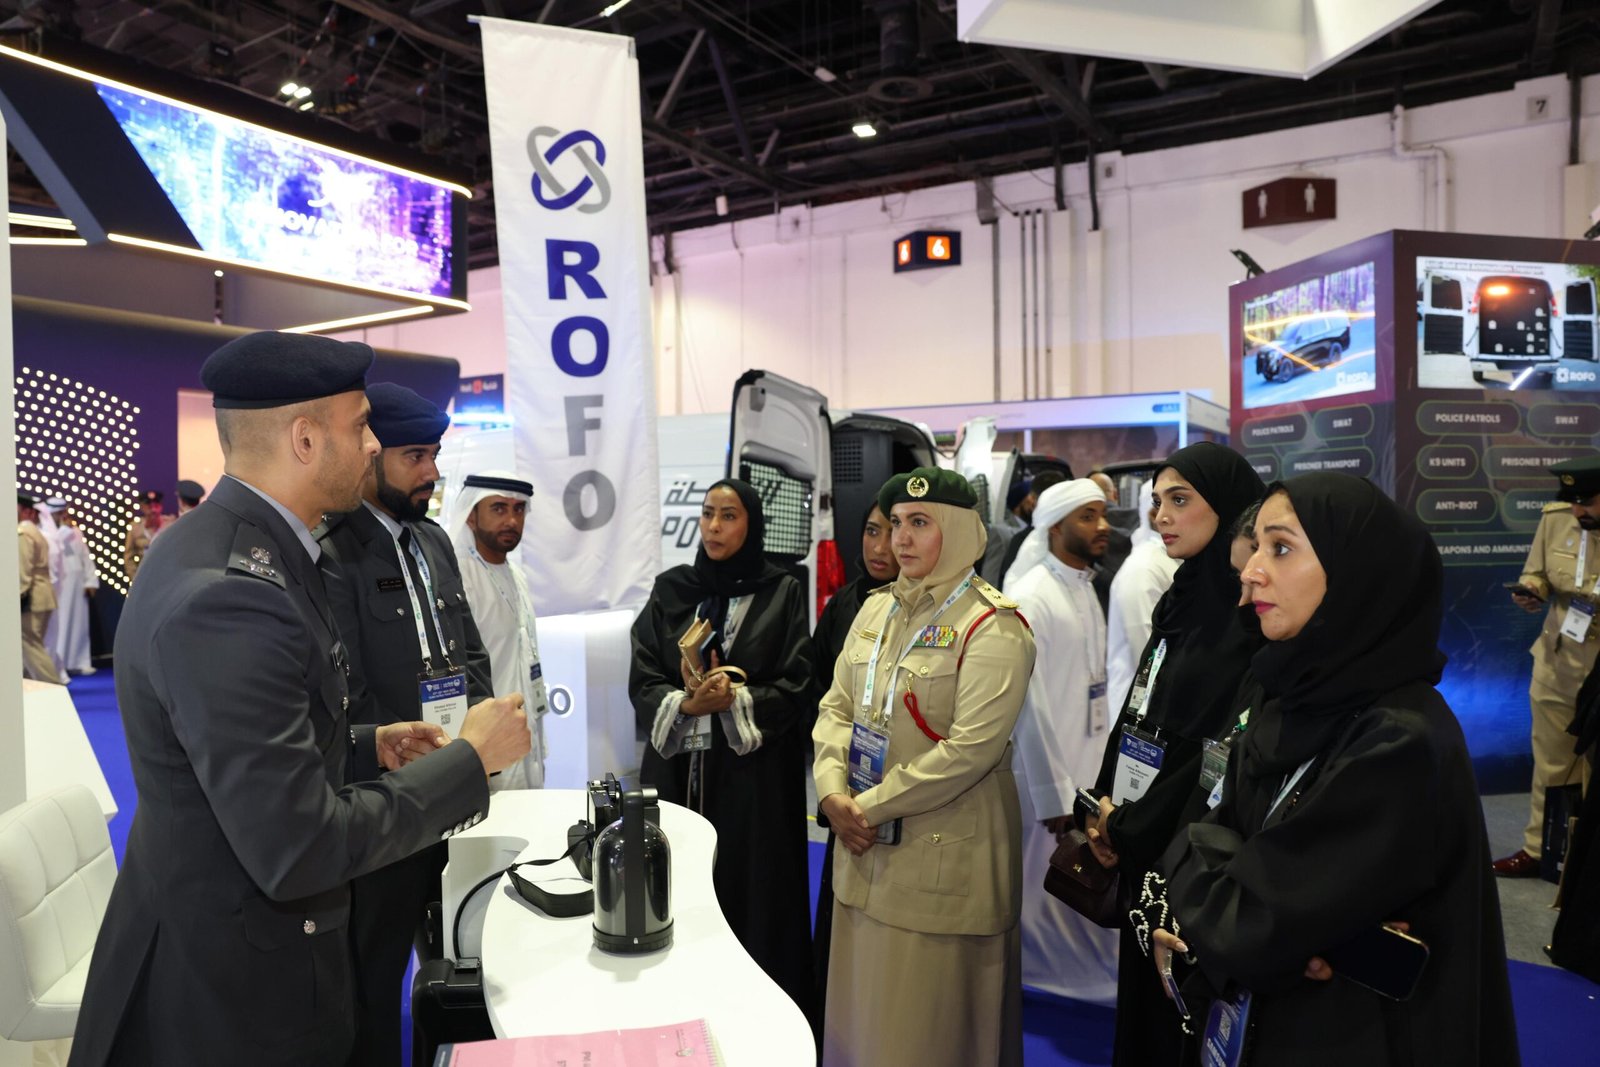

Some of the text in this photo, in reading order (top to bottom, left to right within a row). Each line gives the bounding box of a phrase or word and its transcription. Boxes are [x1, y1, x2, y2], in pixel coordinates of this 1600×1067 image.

[1536, 100, 1546, 114] 7
[932, 238, 945, 257] 6
[1569, 373, 1597, 382] ROFO
[545, 238, 616, 532] ROFO
[1435, 413, 1501, 423] POLICE PATROLS
[1554, 416, 1579, 425] SWAT
[1332, 418, 1352, 428] SWAT
[1323, 459, 1360, 469] TRANSPORT
[1429, 458, 1467, 467] K9 UNITS
[1501, 458, 1540, 467] PRISONER
[1435, 501, 1478, 510] ANTI-RIOT
[1473, 545, 1491, 554] AND
